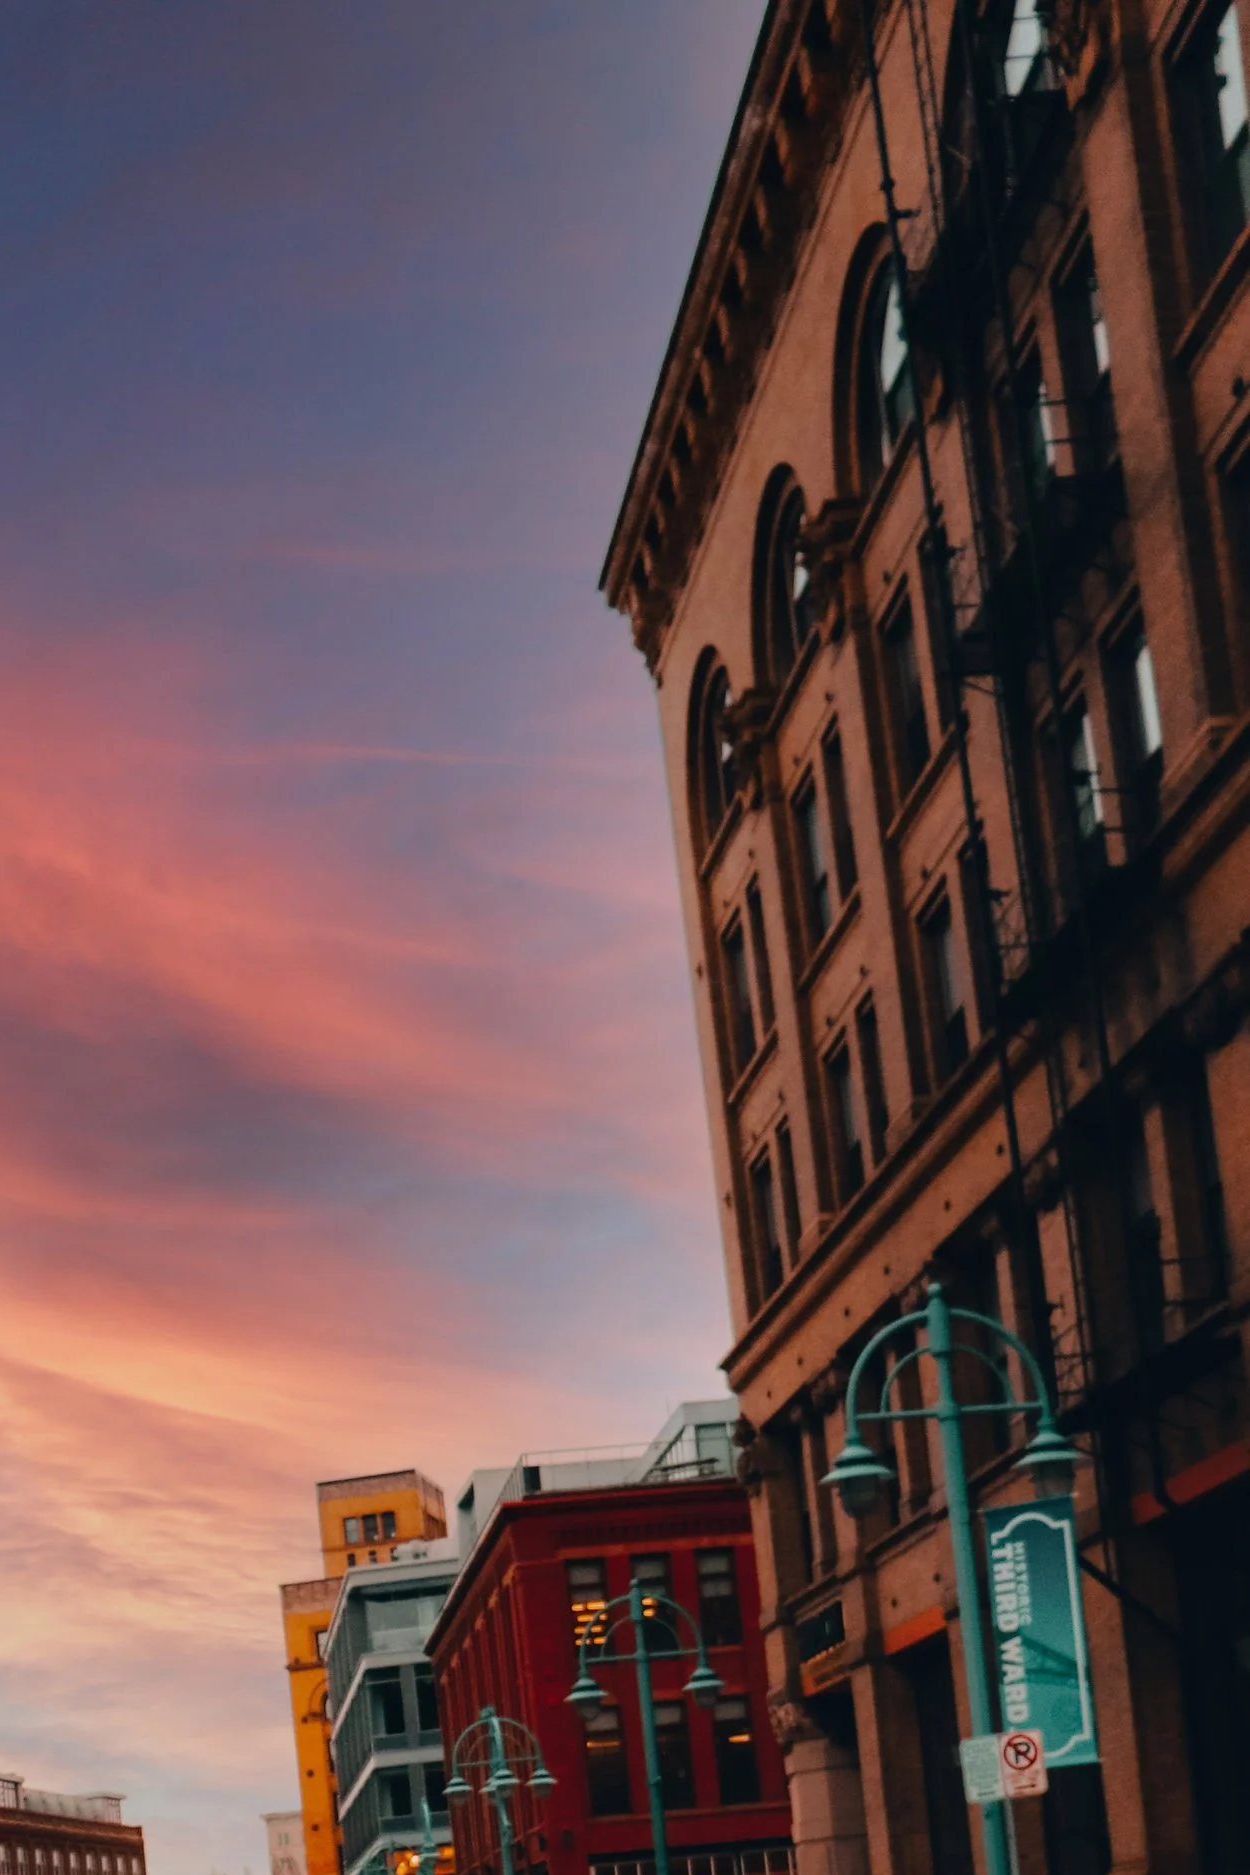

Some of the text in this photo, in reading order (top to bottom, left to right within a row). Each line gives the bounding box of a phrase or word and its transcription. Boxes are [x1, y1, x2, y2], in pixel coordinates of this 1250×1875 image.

[991, 1542, 1030, 1724] THIRD WARD
[1012, 1541, 1033, 1626] HISTORIC
